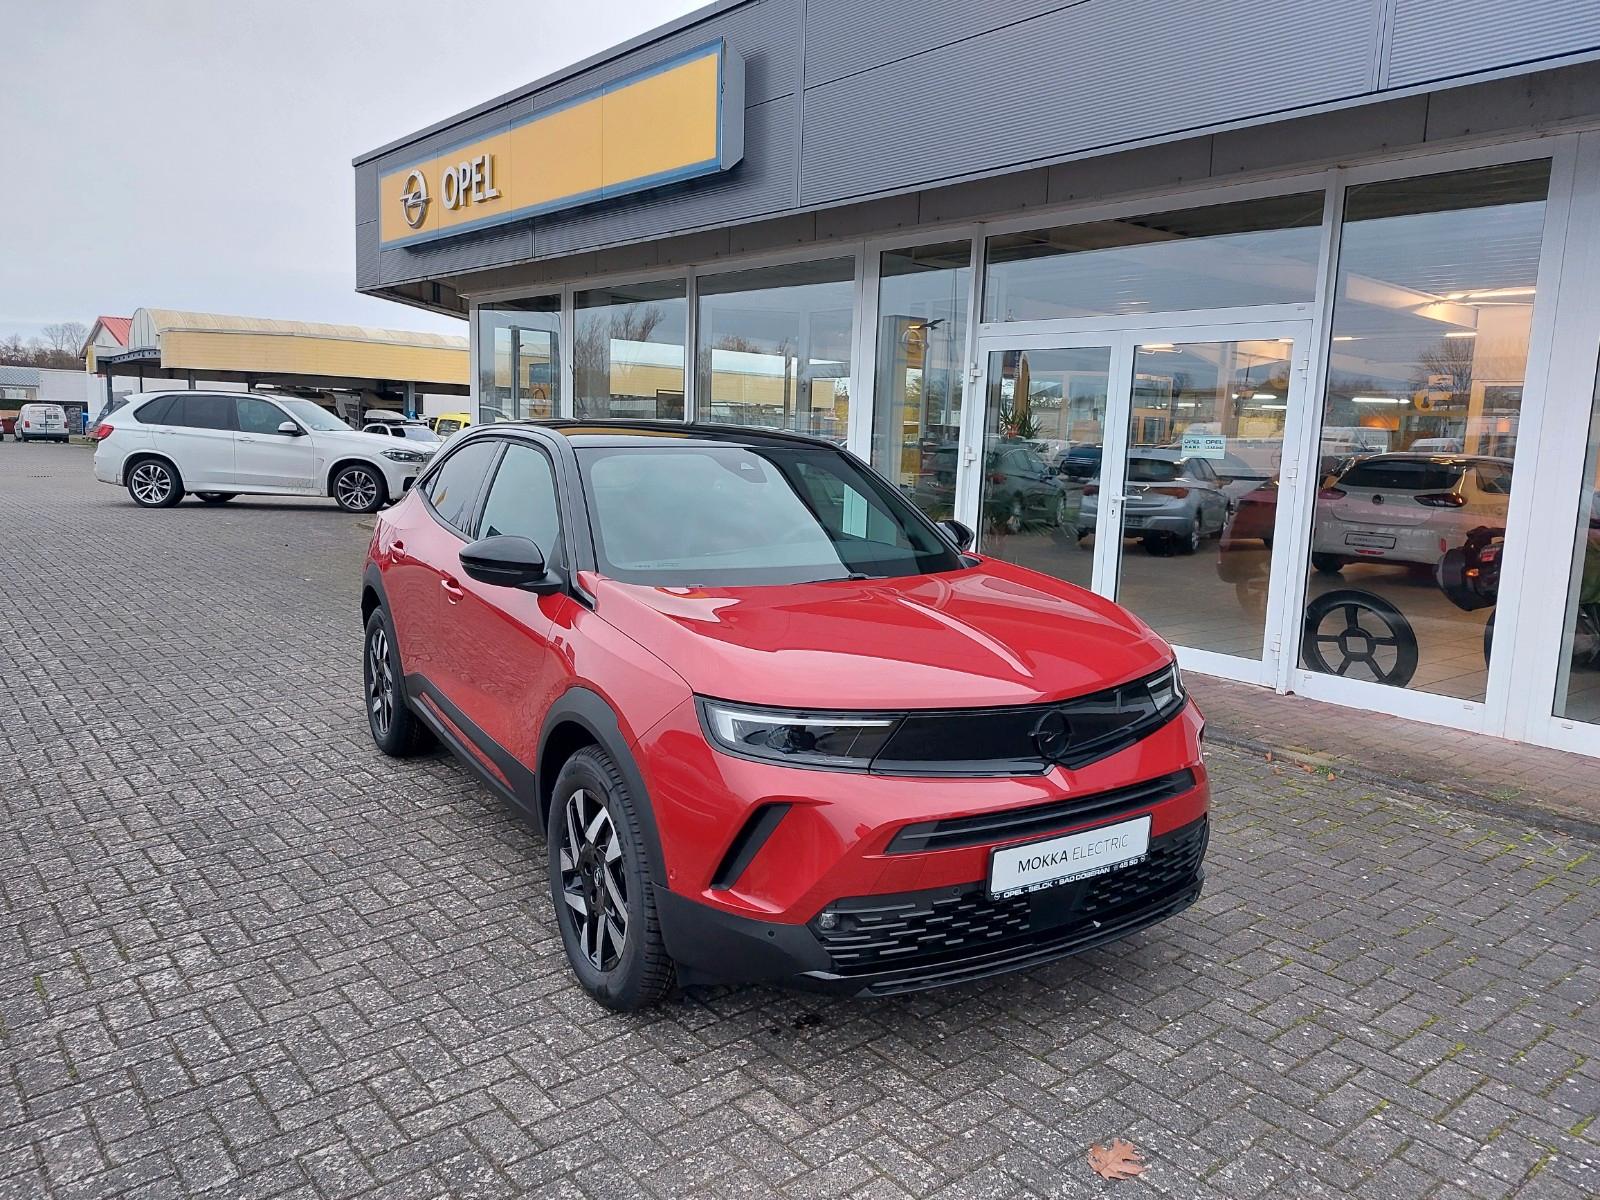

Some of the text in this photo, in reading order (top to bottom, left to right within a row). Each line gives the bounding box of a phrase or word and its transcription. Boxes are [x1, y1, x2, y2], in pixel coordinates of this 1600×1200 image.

[441, 153, 498, 209] OPEL
[1018, 834, 1128, 873] MOKKA ELECTRIC
[1003, 888, 1024, 898] OPEL
[1058, 875, 1075, 885] BAD
